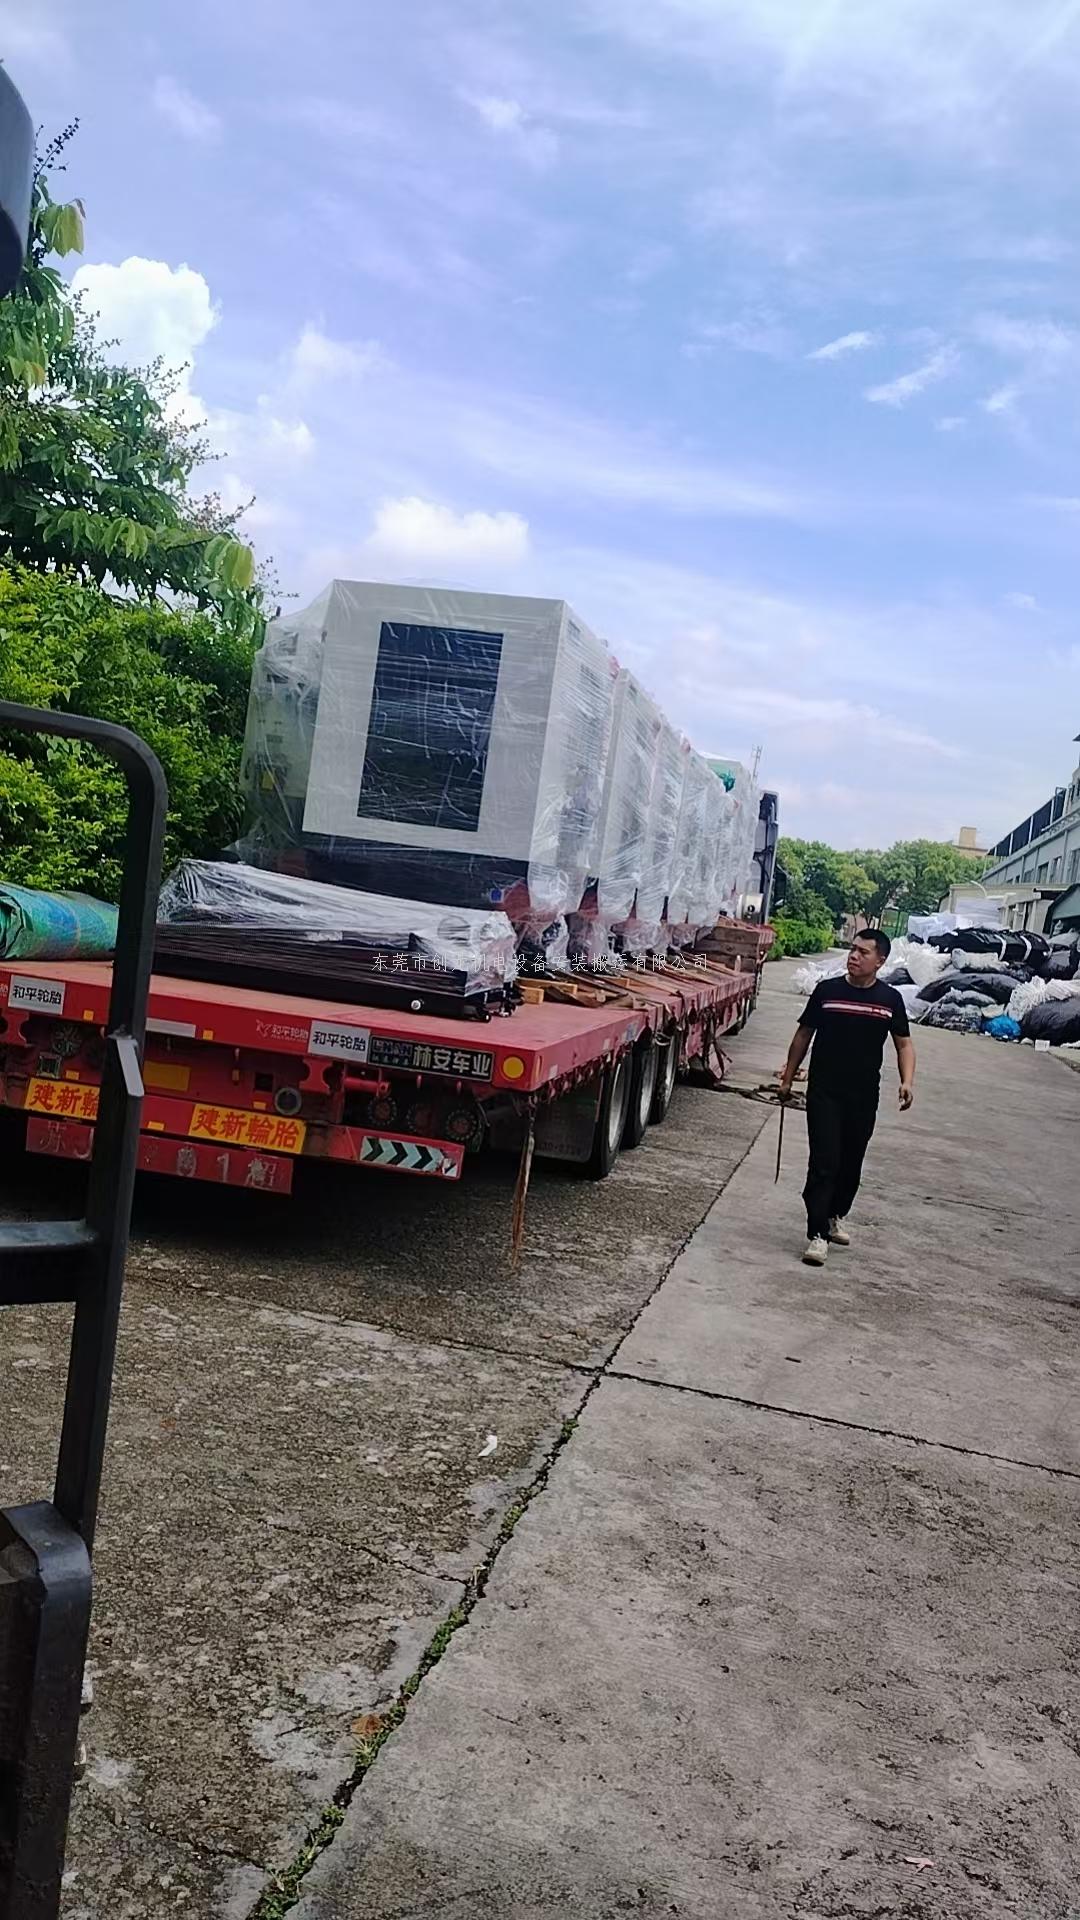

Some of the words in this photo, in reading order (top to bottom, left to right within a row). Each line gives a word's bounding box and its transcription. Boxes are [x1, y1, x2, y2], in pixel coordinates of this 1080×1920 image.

[12, 985, 62, 1005] 和平轮胎
[313, 1031, 366, 1052] 和平轮胎
[413, 1045, 490, 1077] 林安车业
[192, 1108, 300, 1149] 建新輪胎
